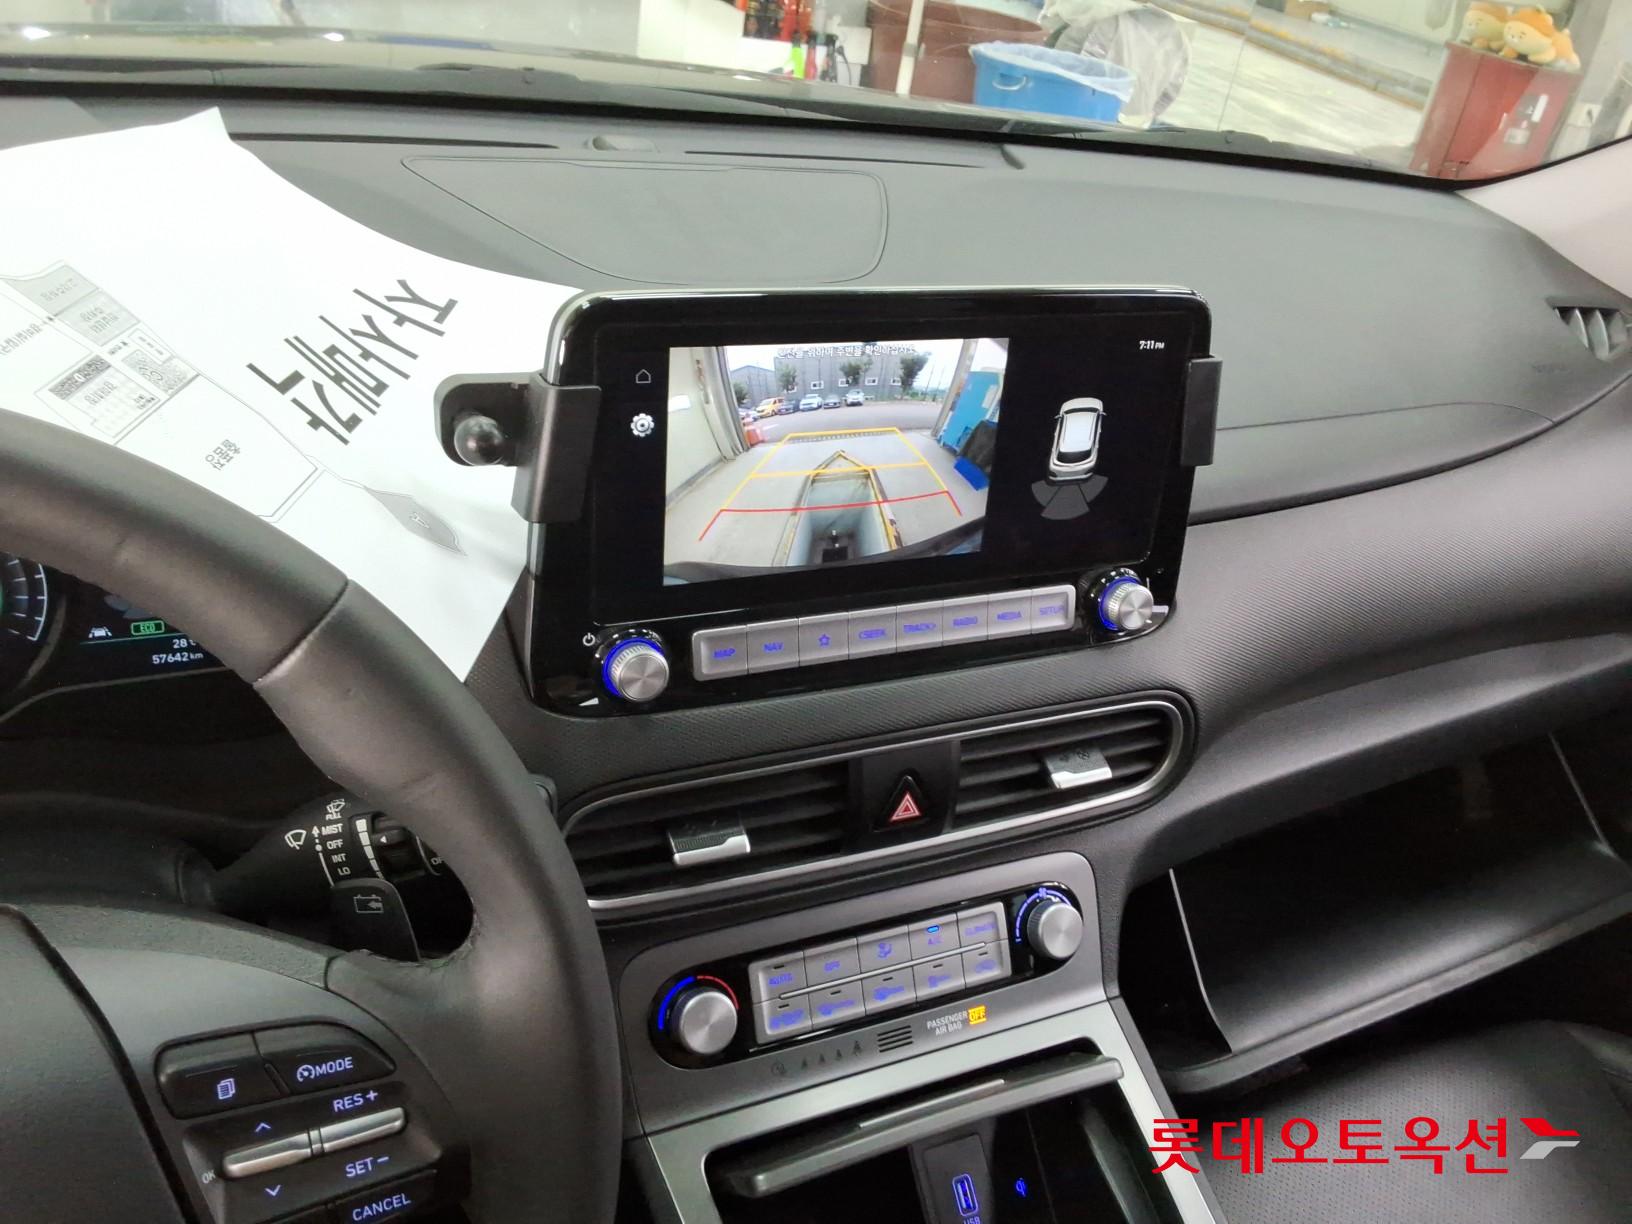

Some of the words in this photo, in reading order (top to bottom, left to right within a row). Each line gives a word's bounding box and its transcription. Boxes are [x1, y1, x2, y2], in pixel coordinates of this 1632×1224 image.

[246, 279, 459, 446] 자사매각
[321, 823, 343, 836] MIST
[326, 839, 344, 850] OFF
[331, 853, 347, 863] INT
[337, 866, 351, 876] LO
[927, 1010, 968, 1030] PASSENGER
[969, 1008, 986, 1023] OFF
[935, 1025, 947, 1036] AIR
[948, 1021, 963, 1032] BAG
[315, 1057, 353, 1076] MODE
[202, 1171, 216, 1184] OK
[352, 1192, 412, 1222] CANCEL
